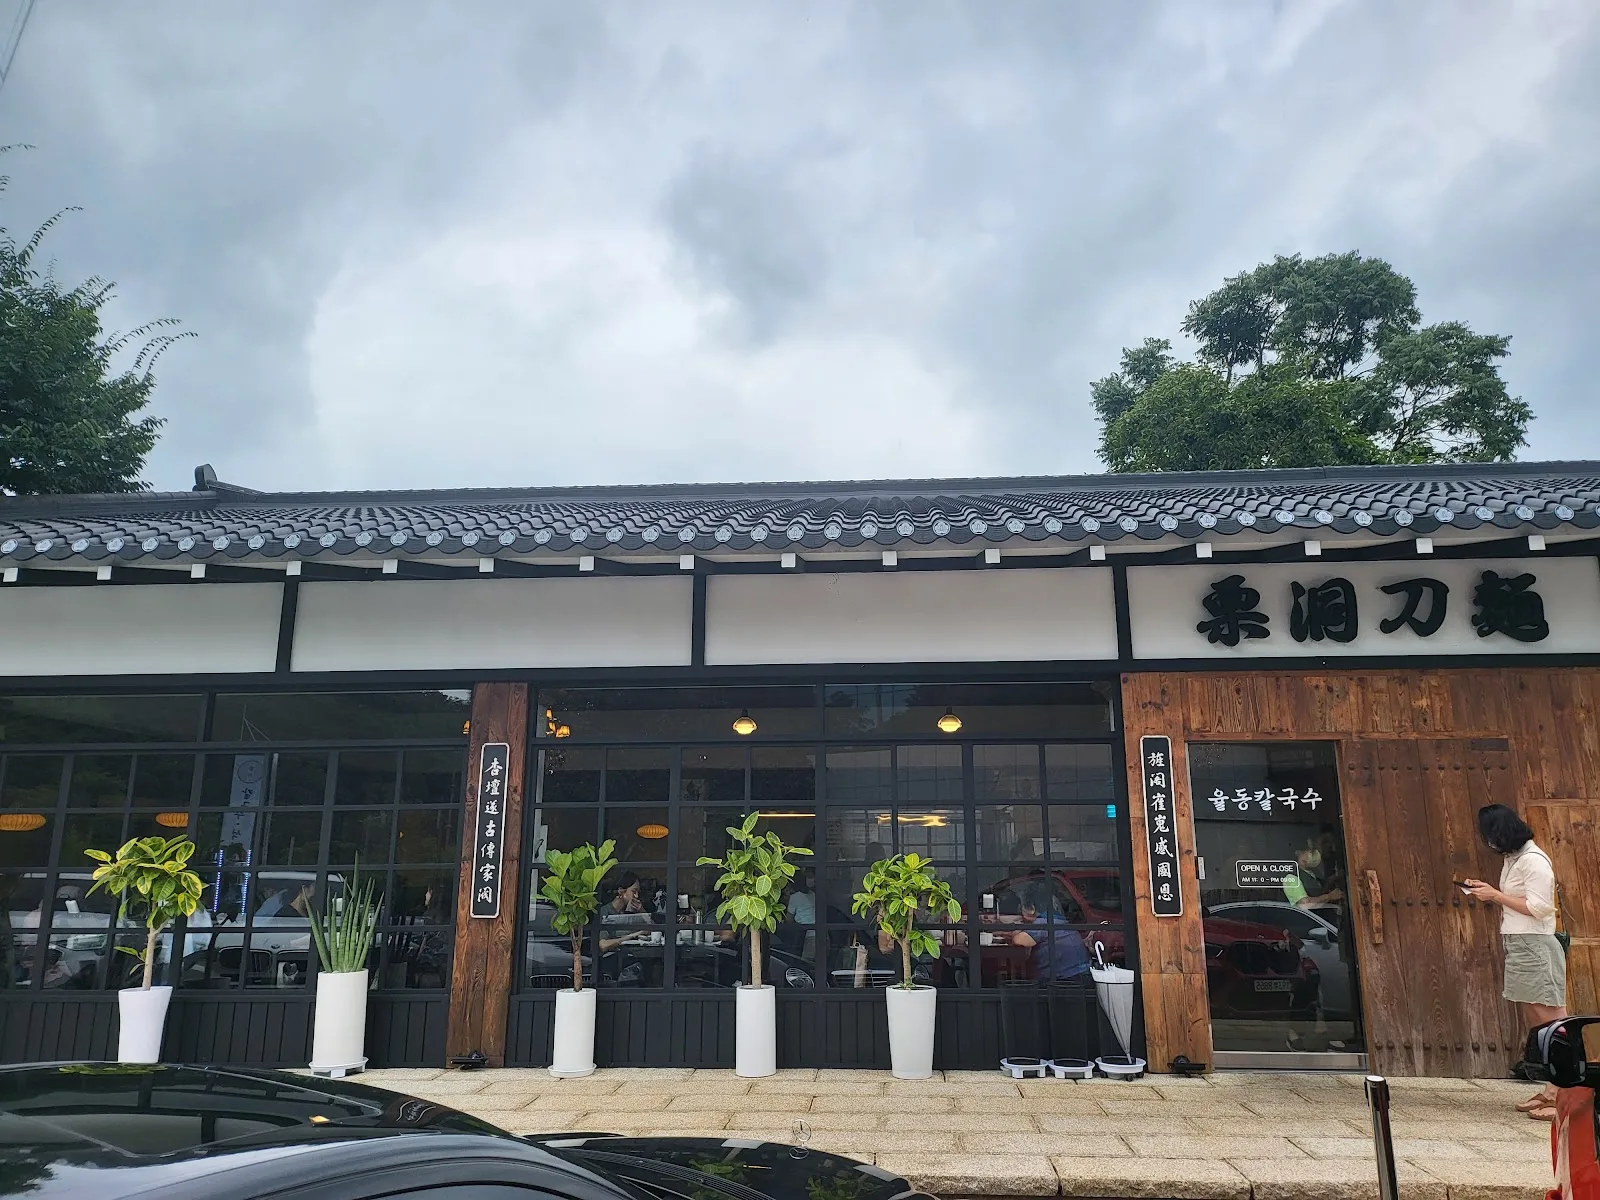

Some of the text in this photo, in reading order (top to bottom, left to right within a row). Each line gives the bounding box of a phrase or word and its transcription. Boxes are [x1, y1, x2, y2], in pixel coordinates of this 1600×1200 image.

[1207, 787, 1323, 812] 율동칼국수
[1240, 864, 1294, 872] OPEN & CLOSE
